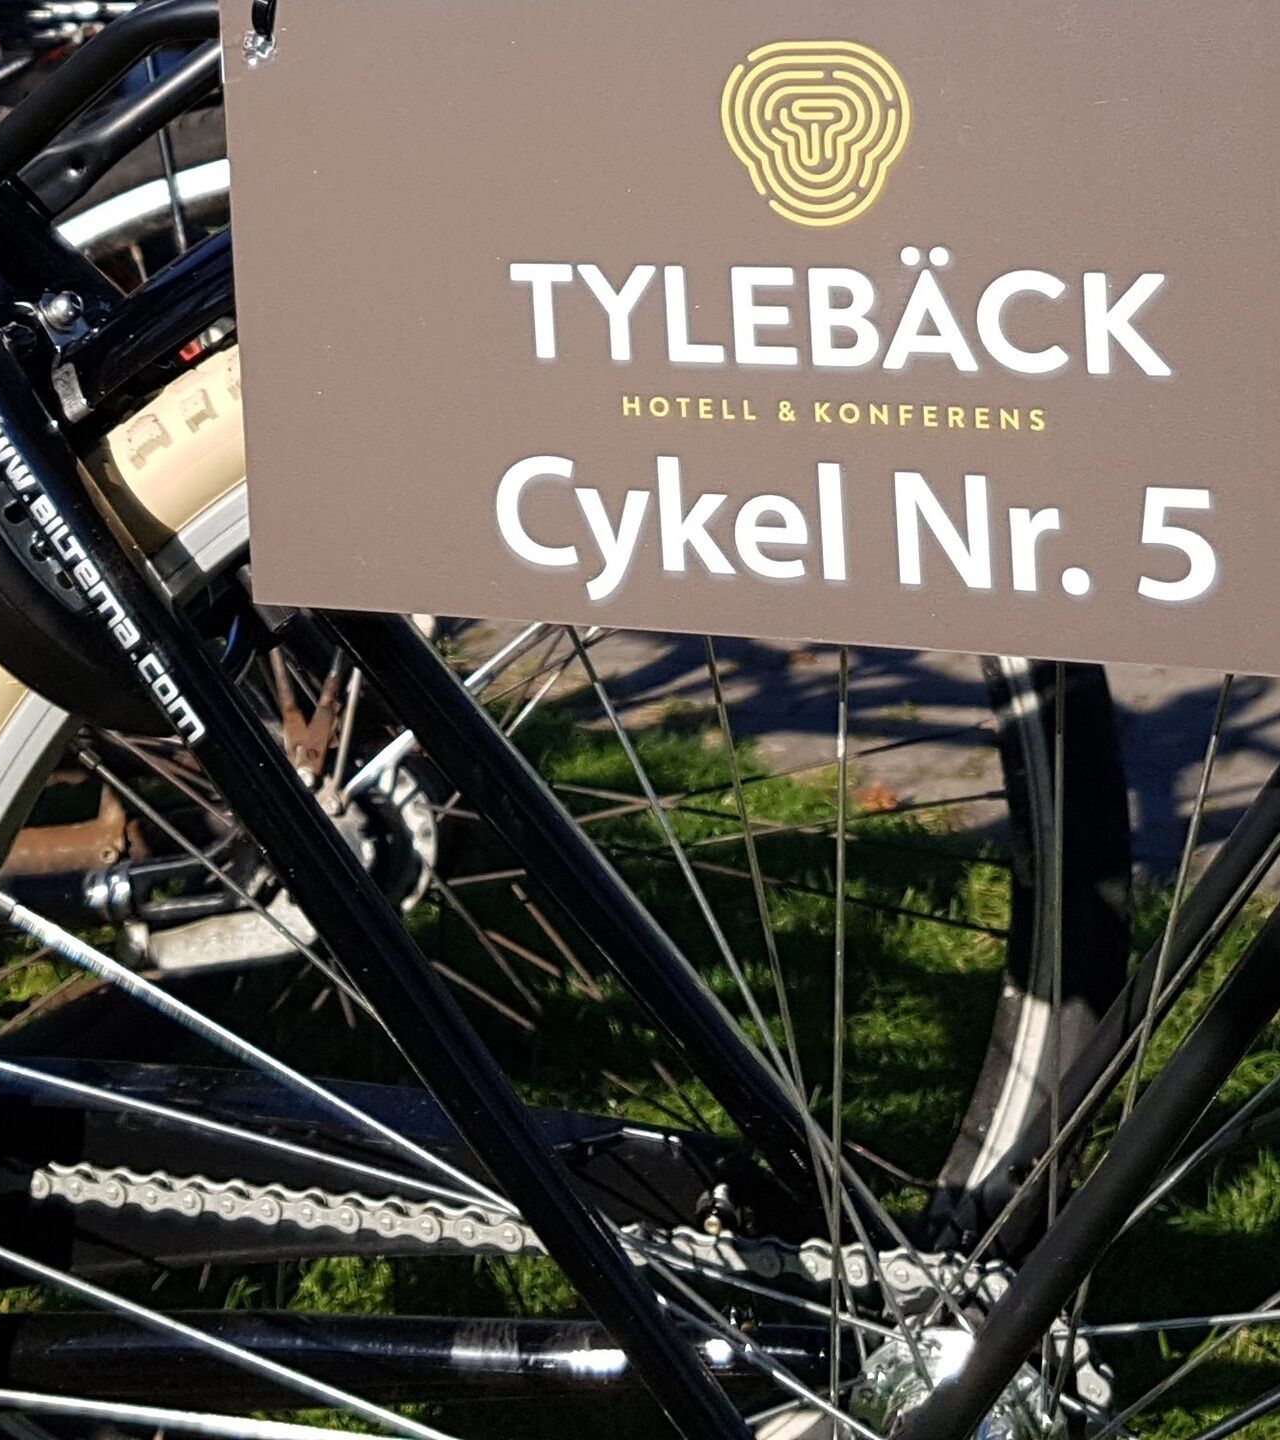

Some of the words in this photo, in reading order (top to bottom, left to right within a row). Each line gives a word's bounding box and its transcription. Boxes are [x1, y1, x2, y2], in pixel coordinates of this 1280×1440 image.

[510, 245, 1172, 377] TYLEBÄCK
[622, 395, 758, 422] HOTELL
[778, 400, 798, 423] &
[814, 401, 1047, 433] KONFERENS
[494, 455, 848, 602] Cykel
[894, 471, 1091, 597] Nr.
[1136, 486, 1219, 603] 5
